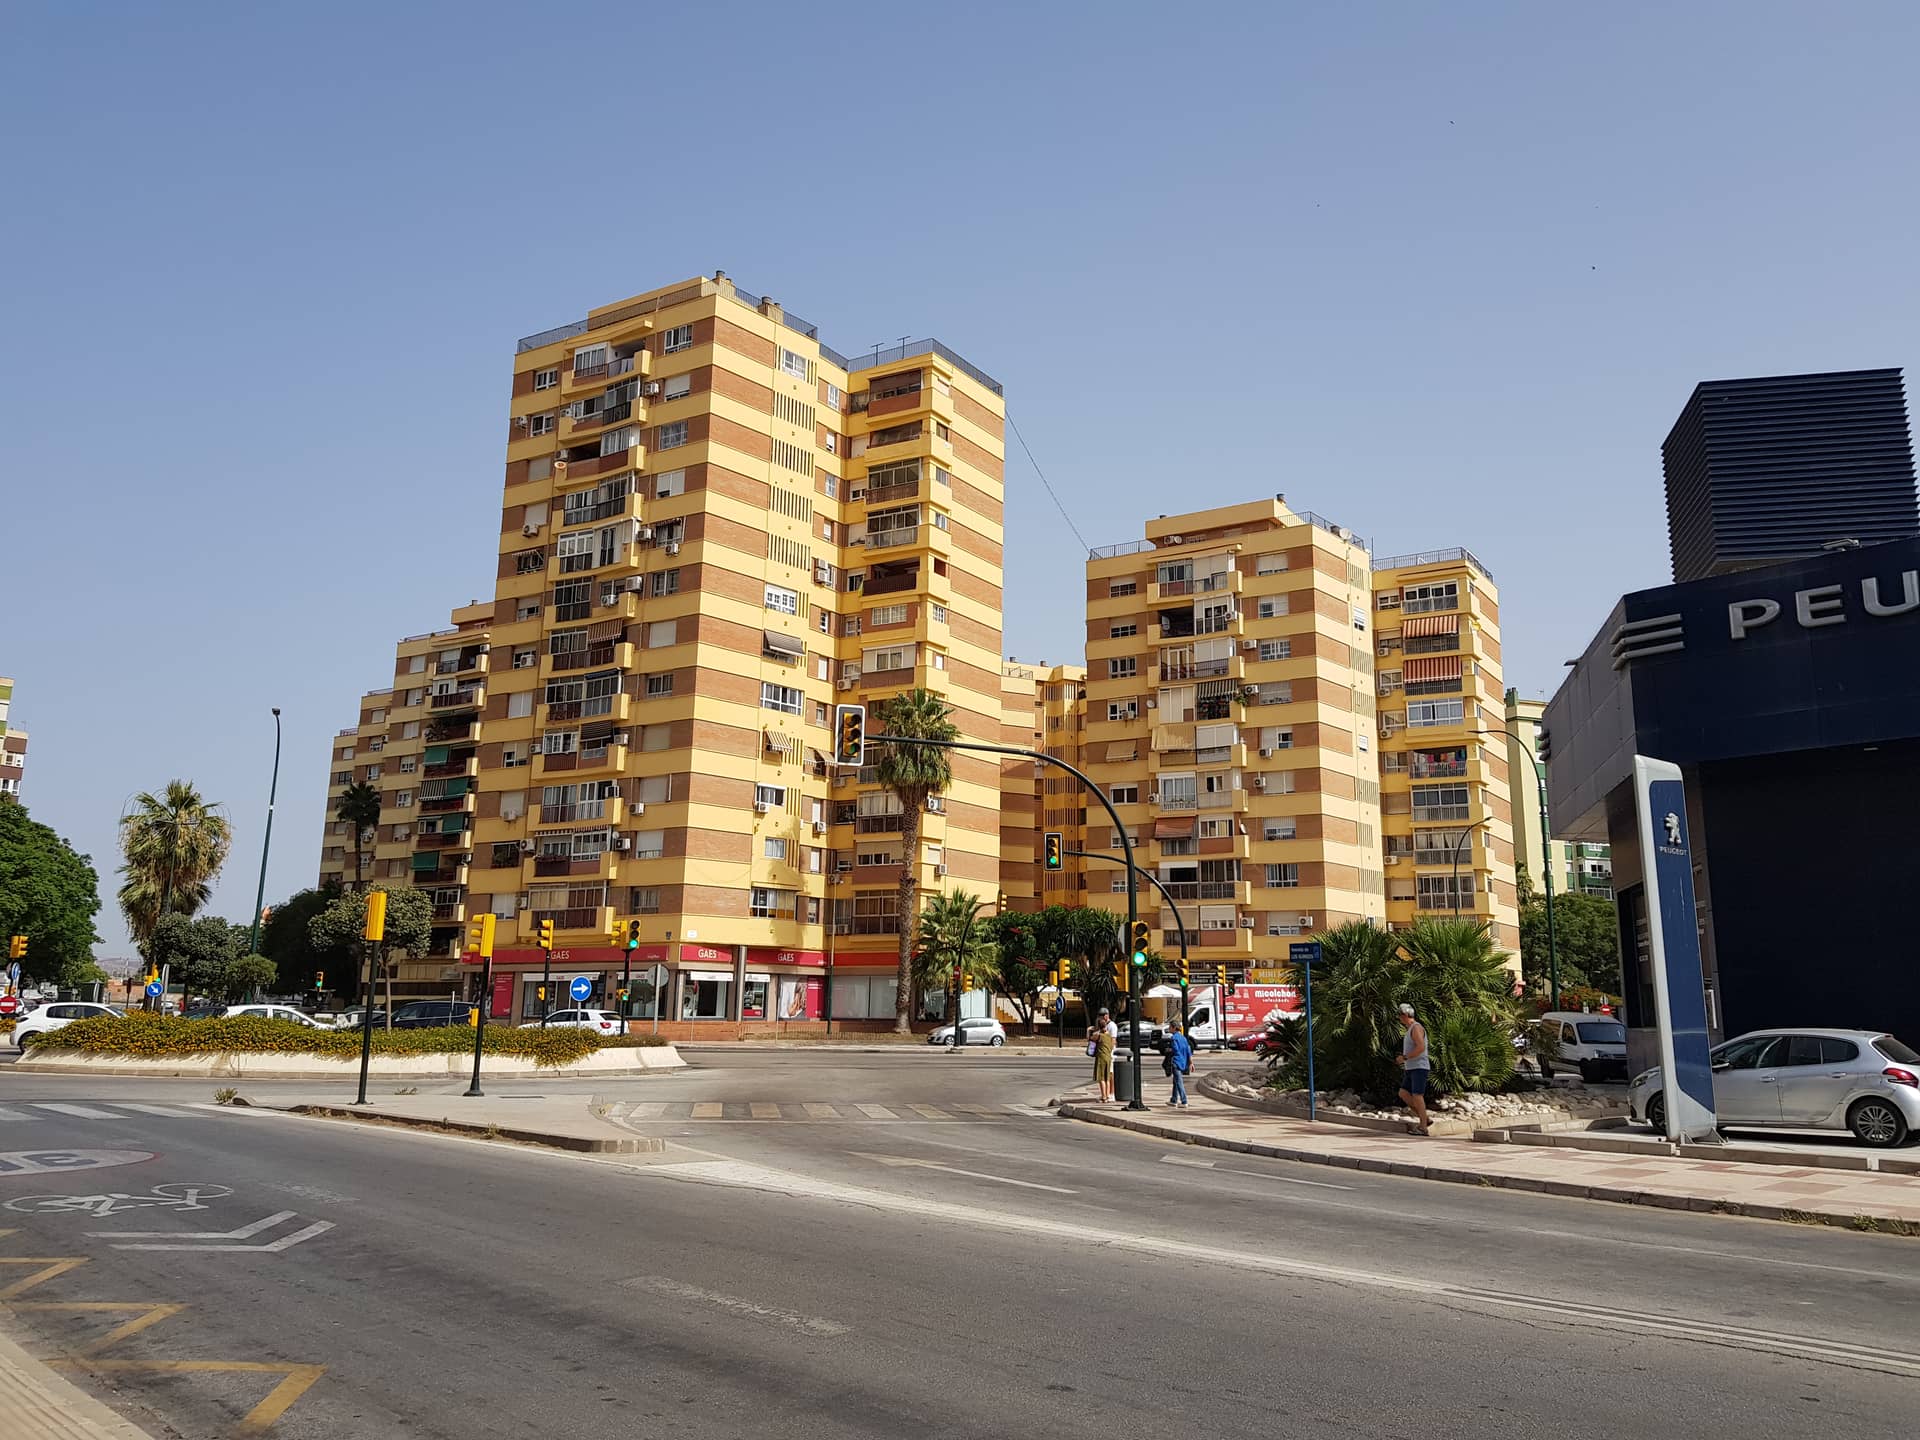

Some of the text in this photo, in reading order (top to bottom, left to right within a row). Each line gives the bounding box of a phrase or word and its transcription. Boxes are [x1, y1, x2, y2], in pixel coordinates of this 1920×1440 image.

[1728, 570, 1920, 640] PEU
[1659, 846, 1687, 855] PEUGEOT
[551, 950, 570, 960] GAES
[698, 949, 717, 958] GAES
[778, 953, 794, 962] GAES
